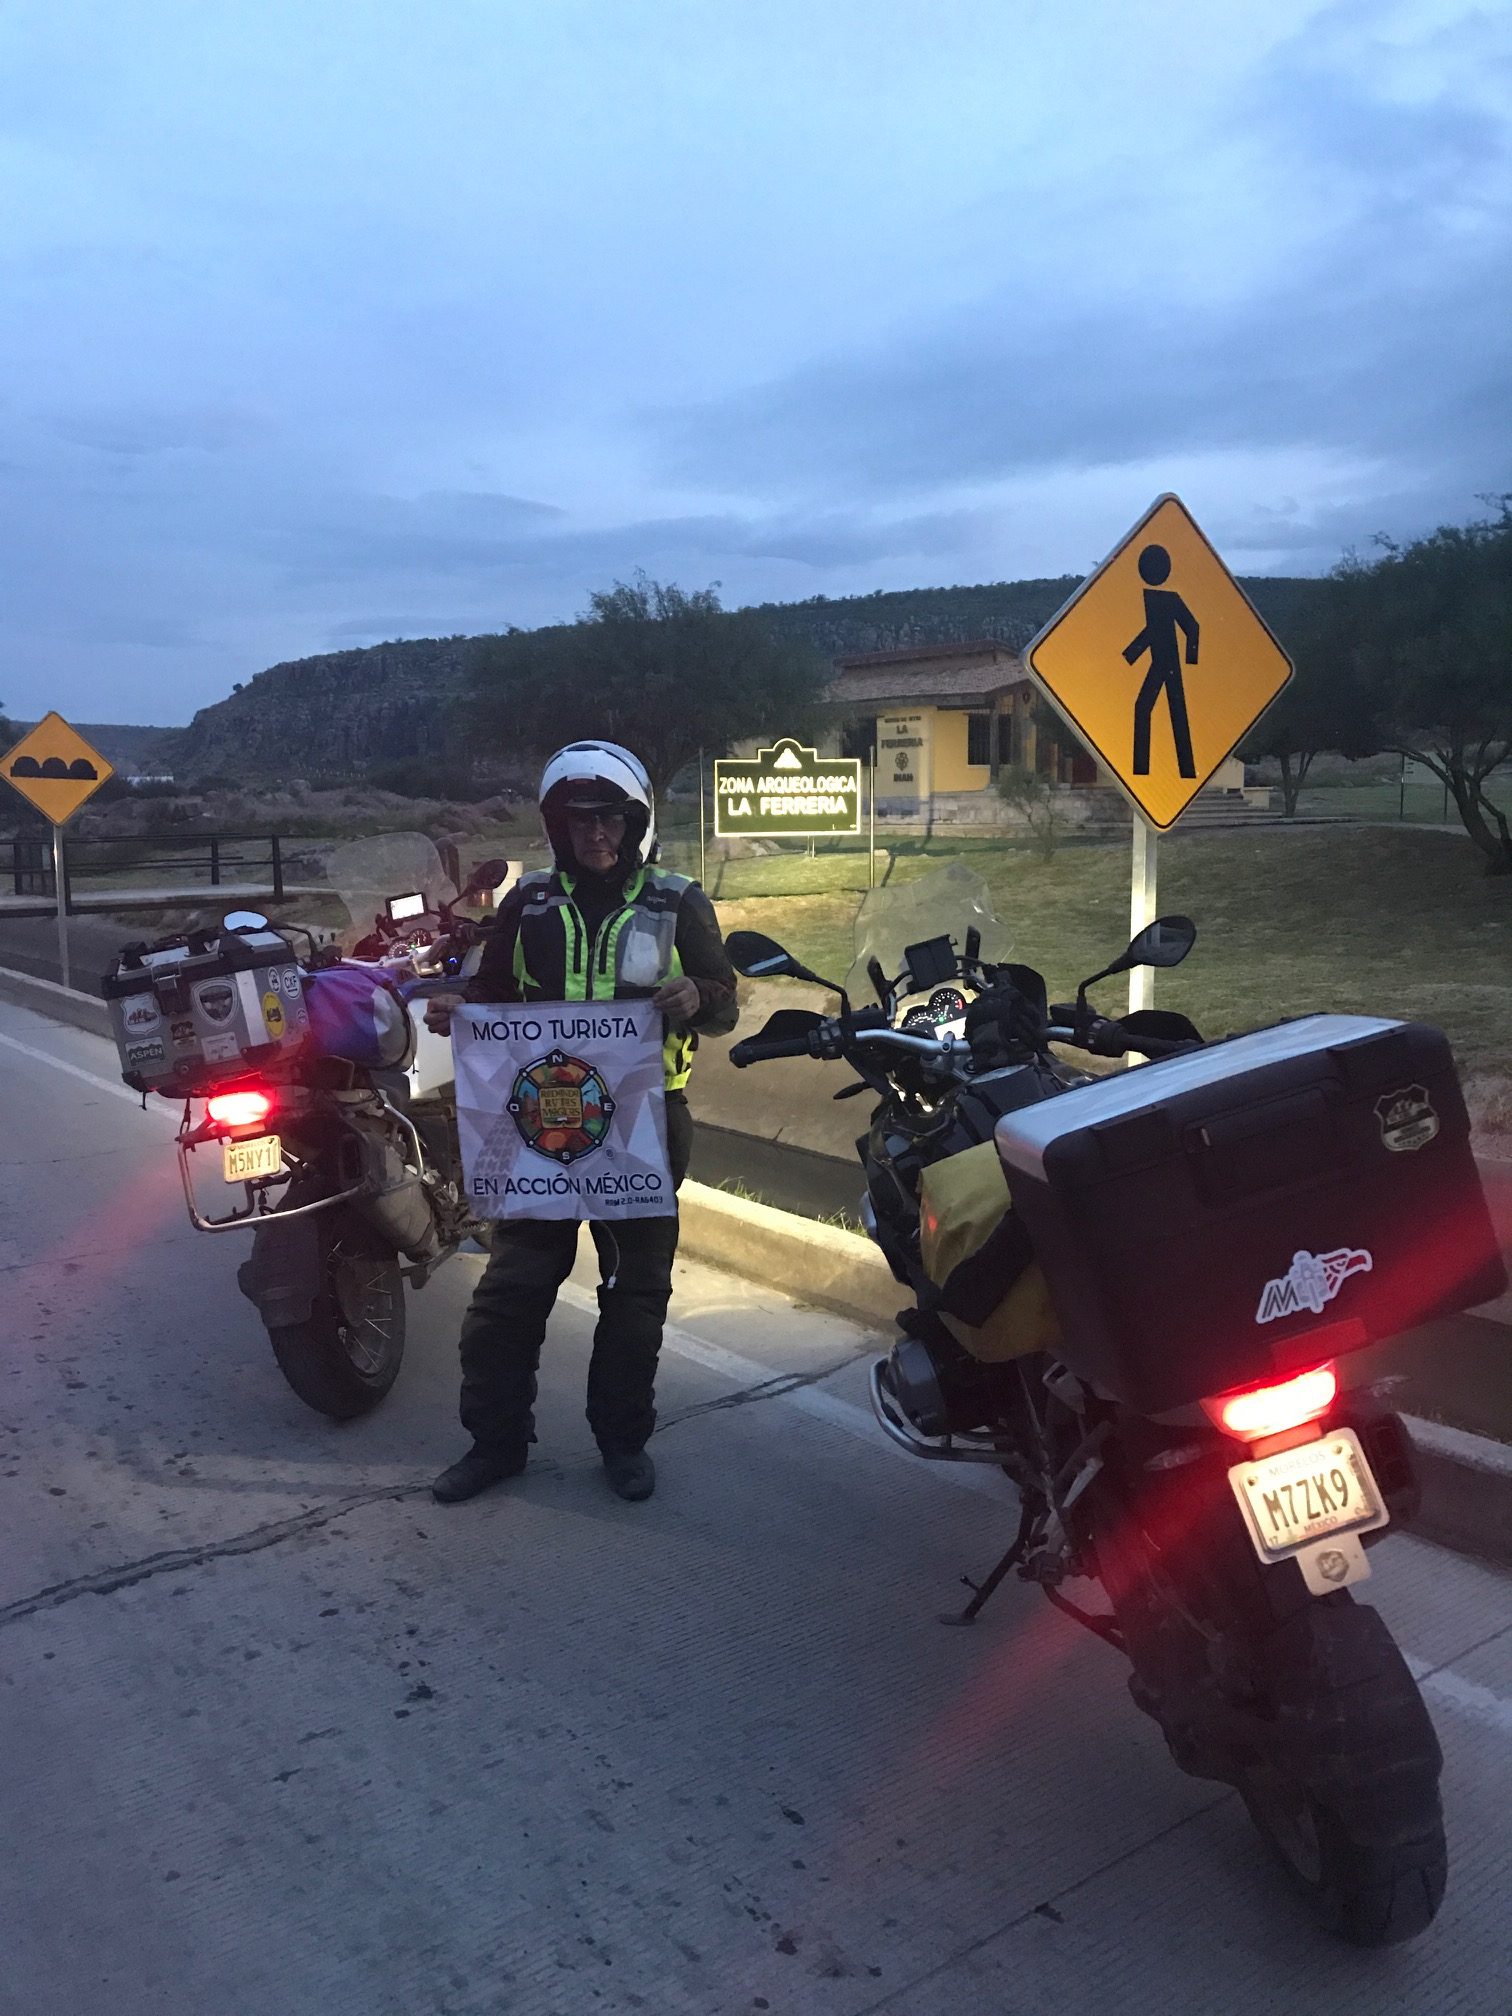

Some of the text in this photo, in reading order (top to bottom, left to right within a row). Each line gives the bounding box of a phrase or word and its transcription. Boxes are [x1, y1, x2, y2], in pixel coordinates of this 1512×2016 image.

[896, 725, 908, 734] LA
[719, 775, 856, 794] ZONA ARQUEOLOGICA
[727, 796, 848, 816] LA FERRERIA
[472, 1017, 638, 1041] MOTO TURISTA
[131, 1047, 163, 1061] ASPEN
[552, 1054, 563, 1063] N
[603, 1103, 613, 1111] E
[229, 1147, 271, 1174] M5NY1
[562, 1151, 570, 1160] S
[473, 1172, 662, 1195] EN ACCIÓN MÉXICO
[1268, 1450, 1326, 1477] MORELOS
[1262, 1468, 1349, 1531] M7ZK9
